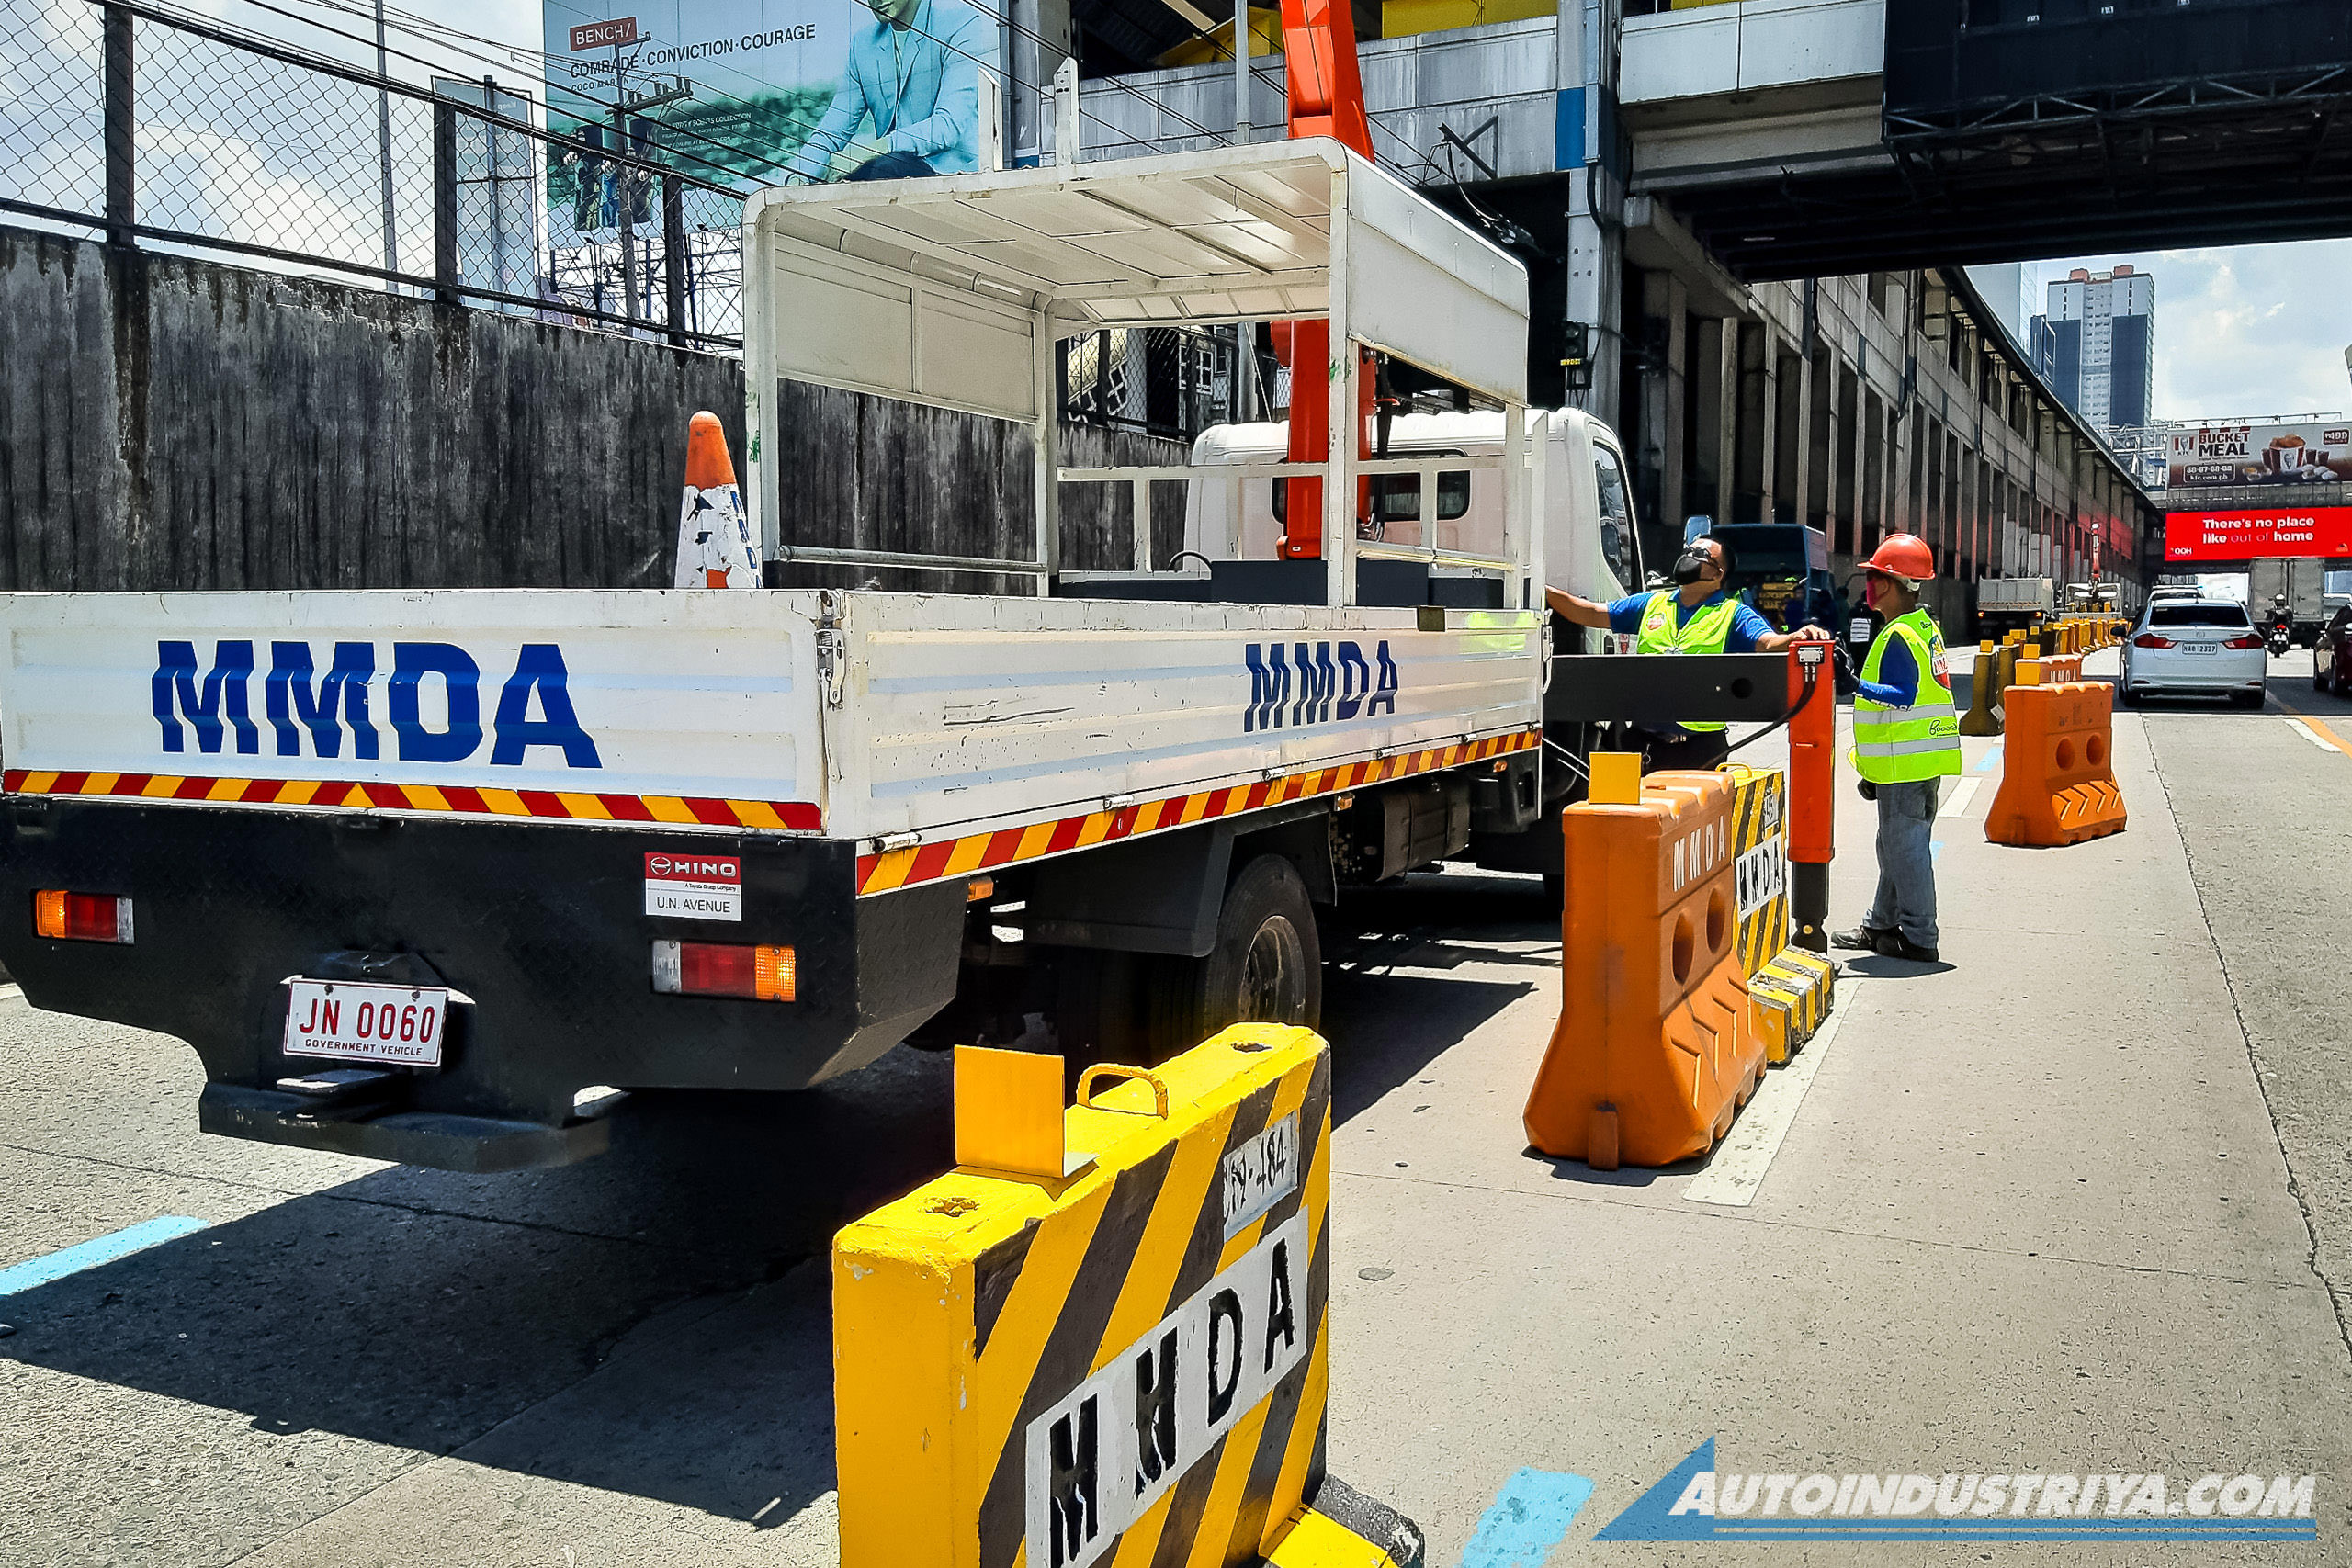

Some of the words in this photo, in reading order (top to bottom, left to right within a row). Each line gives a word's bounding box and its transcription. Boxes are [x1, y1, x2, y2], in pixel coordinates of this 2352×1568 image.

[741, 24, 815, 51] COURAGE
[597, 76, 629, 88] MARN
[2199, 432, 2250, 444] BUCKET
[2199, 443, 2250, 457] MEAL
[2202, 517, 2252, 529] There's
[2255, 518, 2273, 528] no
[2277, 516, 2314, 530] place
[2202, 533, 2227, 544] like
[2273, 530, 2314, 542] home
[1244, 640, 1398, 733] MMDA
[151, 640, 603, 769] MMDA
[1673, 815, 1726, 893] MMDA
[674, 861, 737, 878] HINO
[1739, 840, 1781, 912] MMDA
[657, 897, 681, 909] U.N.
[683, 898, 731, 913] AVENUE
[299, 998, 341, 1036] JN
[356, 1001, 435, 1043] 0060
[305, 1038, 377, 1053] GOVERNMENT
[380, 1044, 424, 1056] VEHICLE
[1049, 1237, 1295, 1568] MMDA
